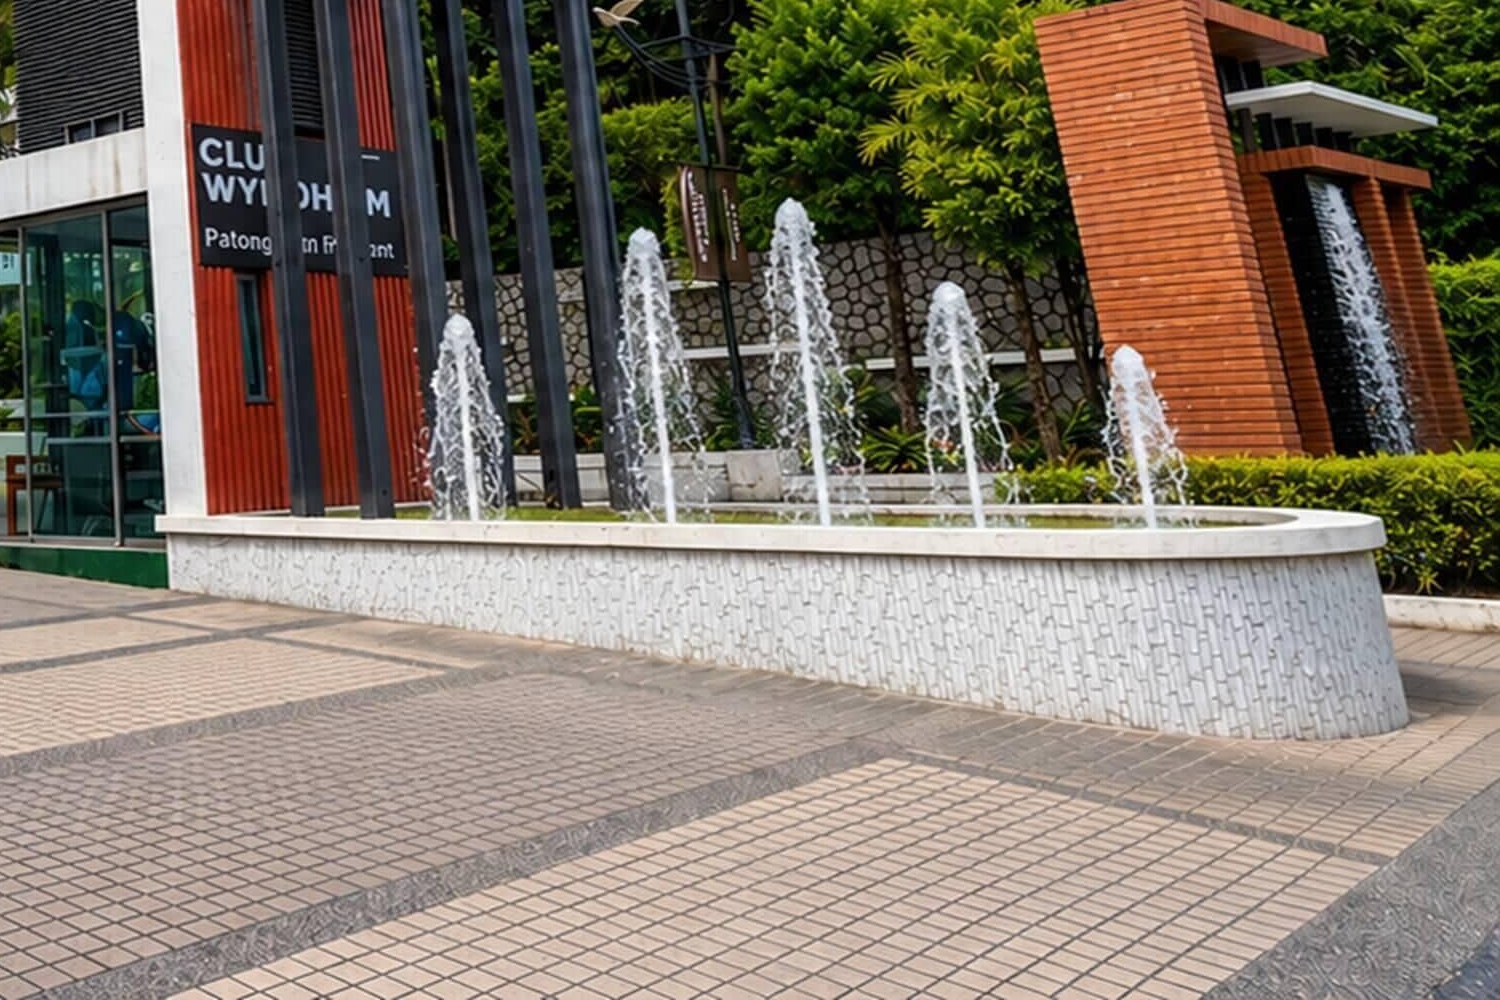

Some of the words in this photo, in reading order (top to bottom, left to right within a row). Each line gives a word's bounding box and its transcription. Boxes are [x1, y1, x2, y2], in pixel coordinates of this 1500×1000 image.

[199, 137, 265, 171] CLU
[201, 171, 391, 218] WYDHM
[205, 227, 272, 256] Patong
